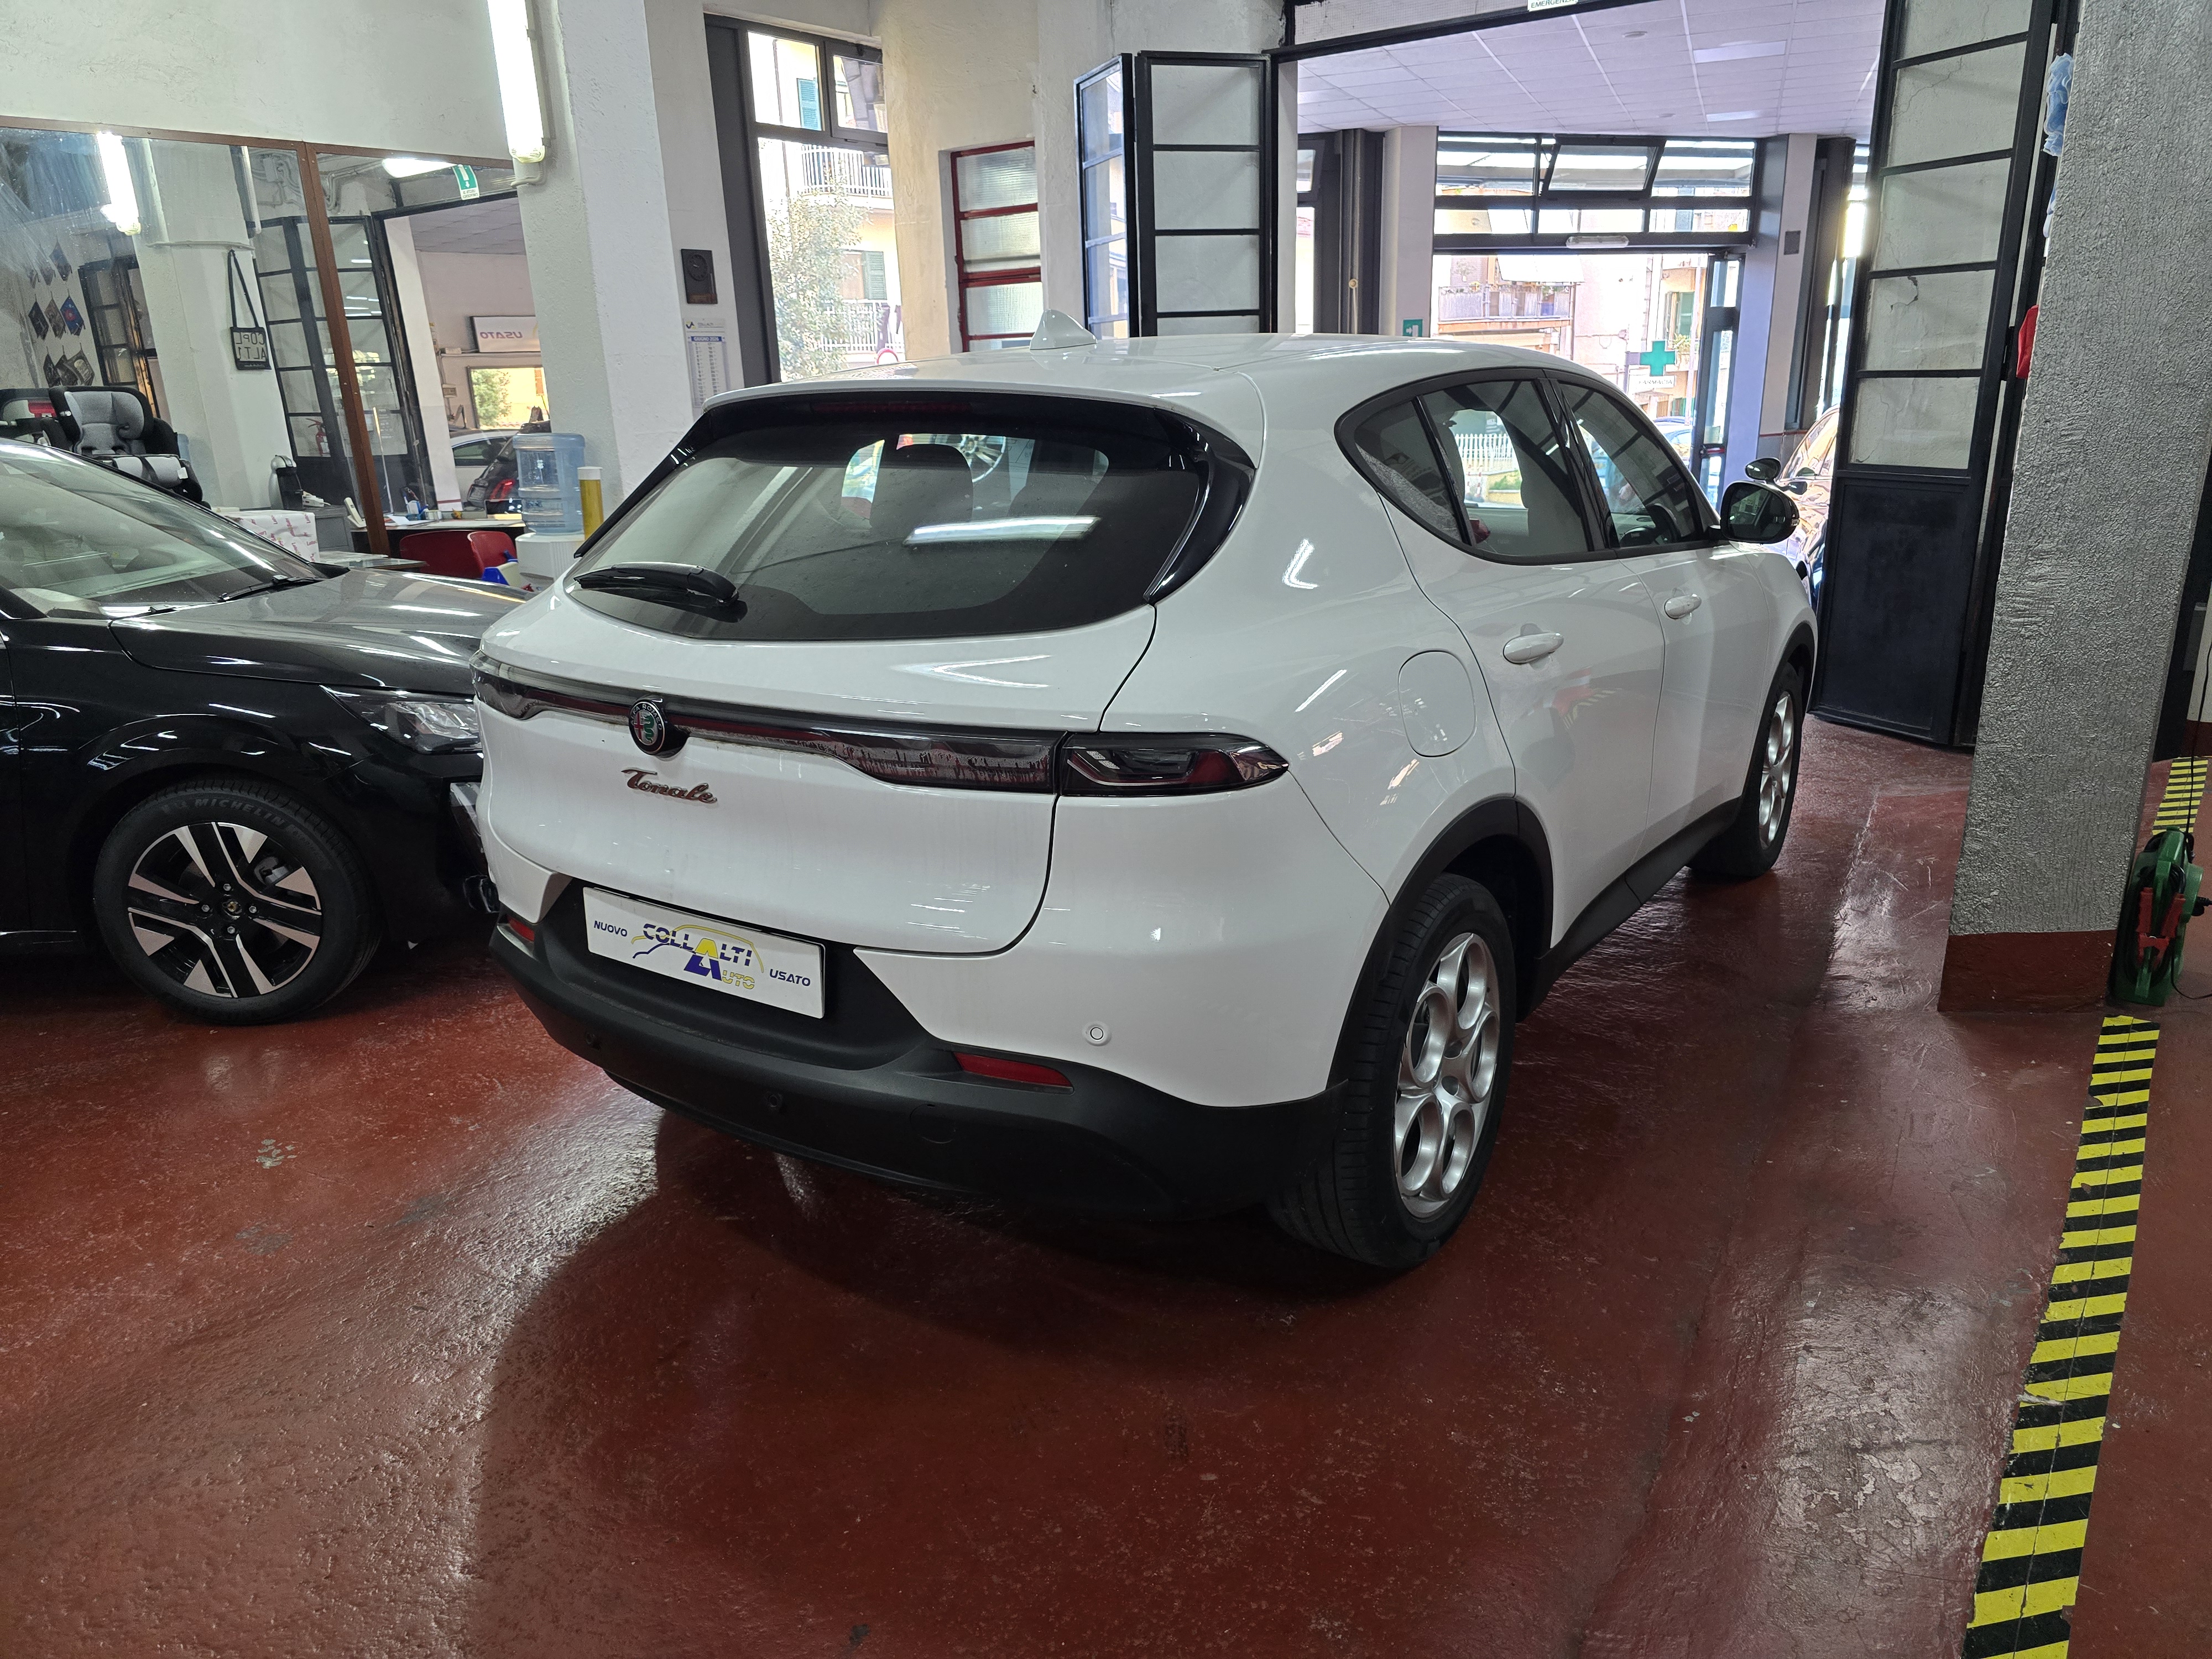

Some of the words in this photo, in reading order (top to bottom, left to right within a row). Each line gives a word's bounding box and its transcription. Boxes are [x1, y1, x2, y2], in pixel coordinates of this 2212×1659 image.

[642, 703, 662, 731] ROMEO
[620, 768, 718, 804] Tonale
[195, 798, 285, 828] MICHELIN
[593, 920, 628, 938] NUOVO
[769, 969, 811, 987] USATO
